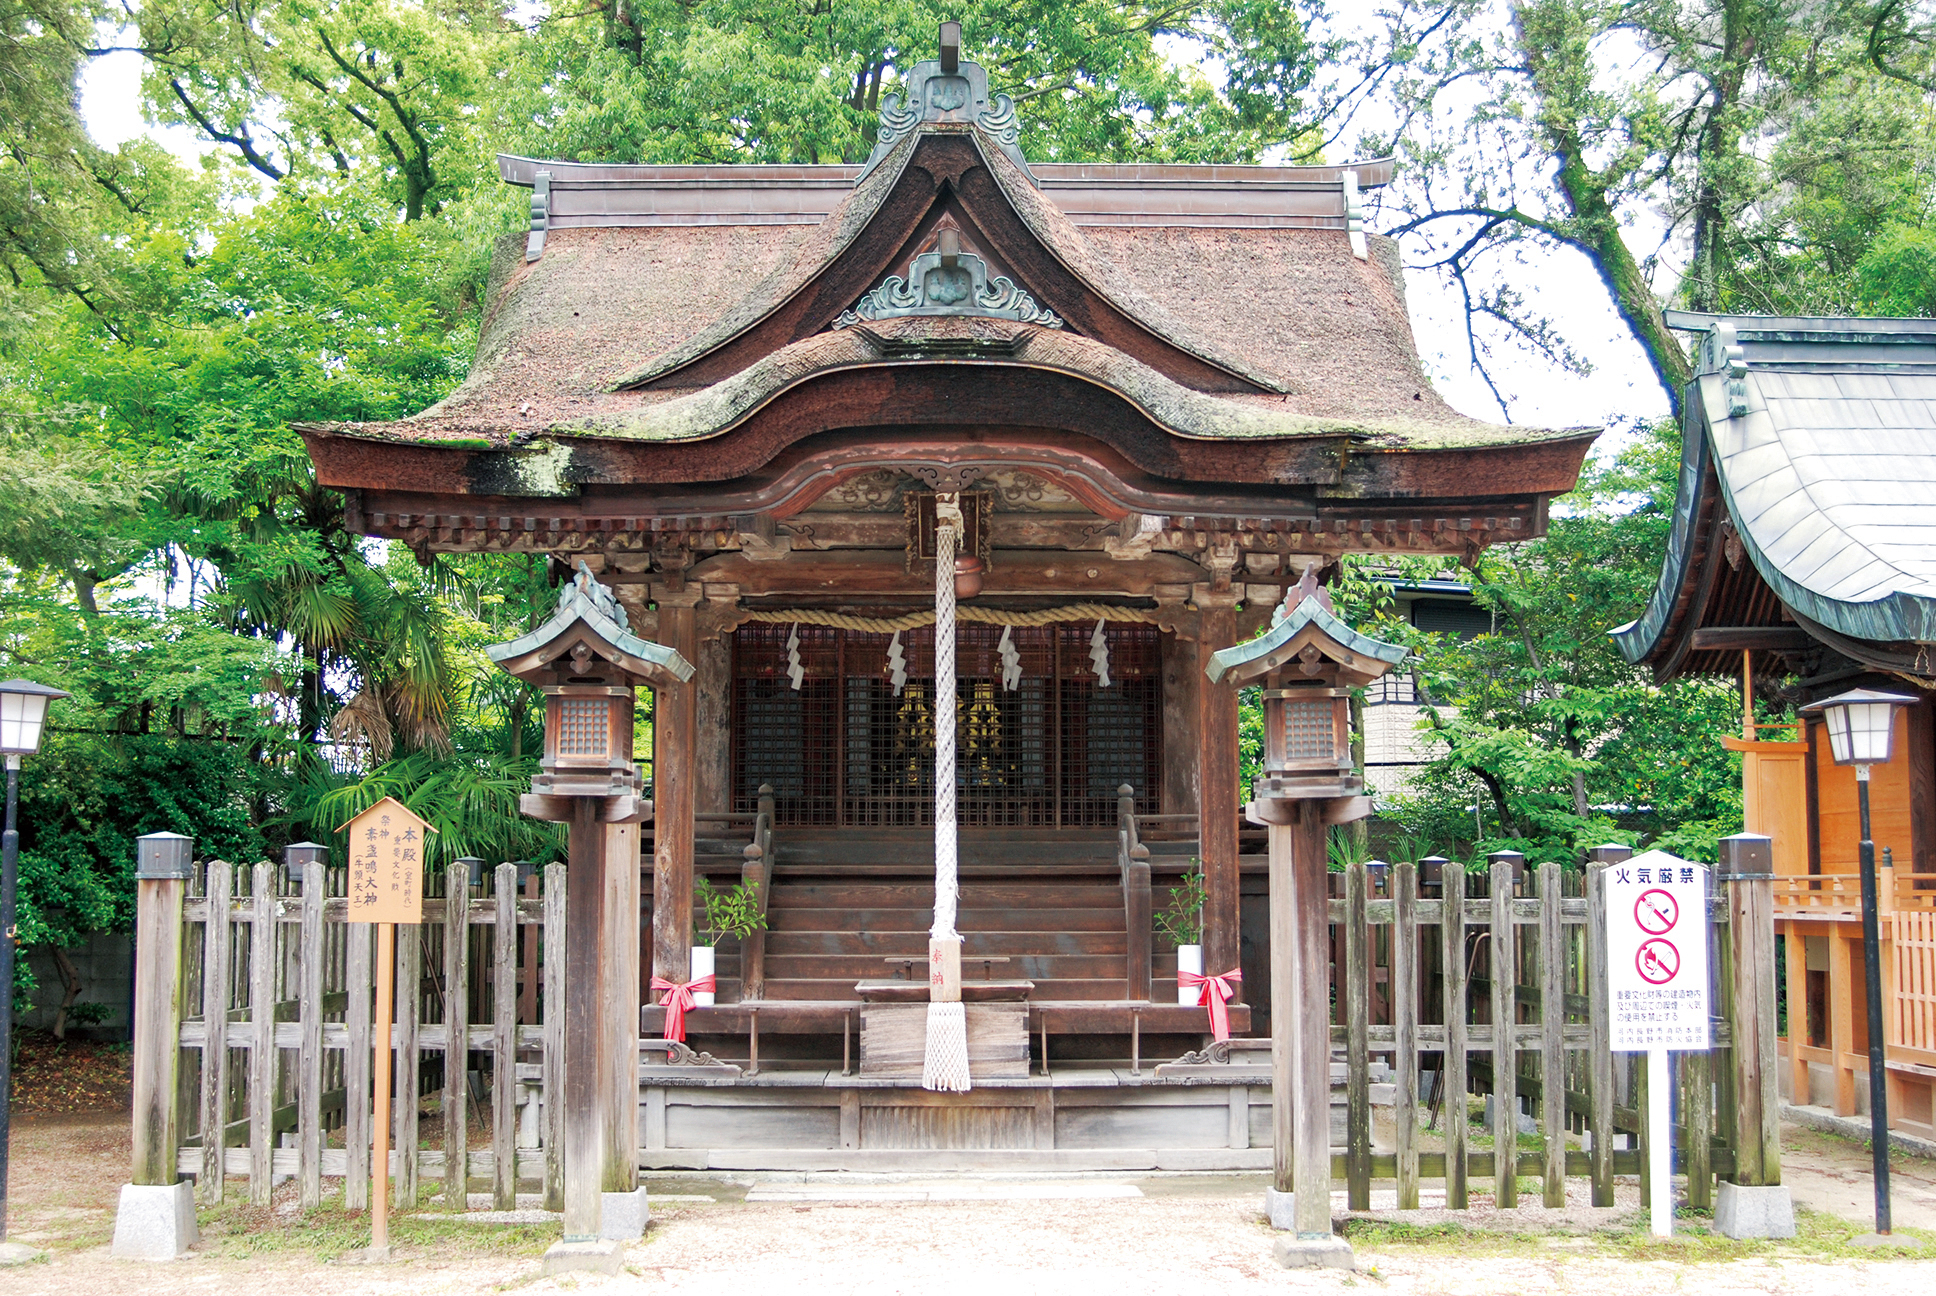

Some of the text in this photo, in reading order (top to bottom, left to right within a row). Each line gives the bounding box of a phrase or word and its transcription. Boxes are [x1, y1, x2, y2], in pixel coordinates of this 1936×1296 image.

[379, 814, 391, 840] 祭神
[392, 835, 401, 891] 重要文化財
[354, 855, 363, 908] （牛頭天王）
[1616, 867, 1694, 884] 火気厳禁
[931, 949, 944, 986] 奉納
[1617, 989, 1701, 1000] 重要文化財等の建造物内
[1617, 1000, 1702, 1011] 及び周辺での喫煙・火気
[1617, 1012, 1679, 1022] の使用を禁止する
